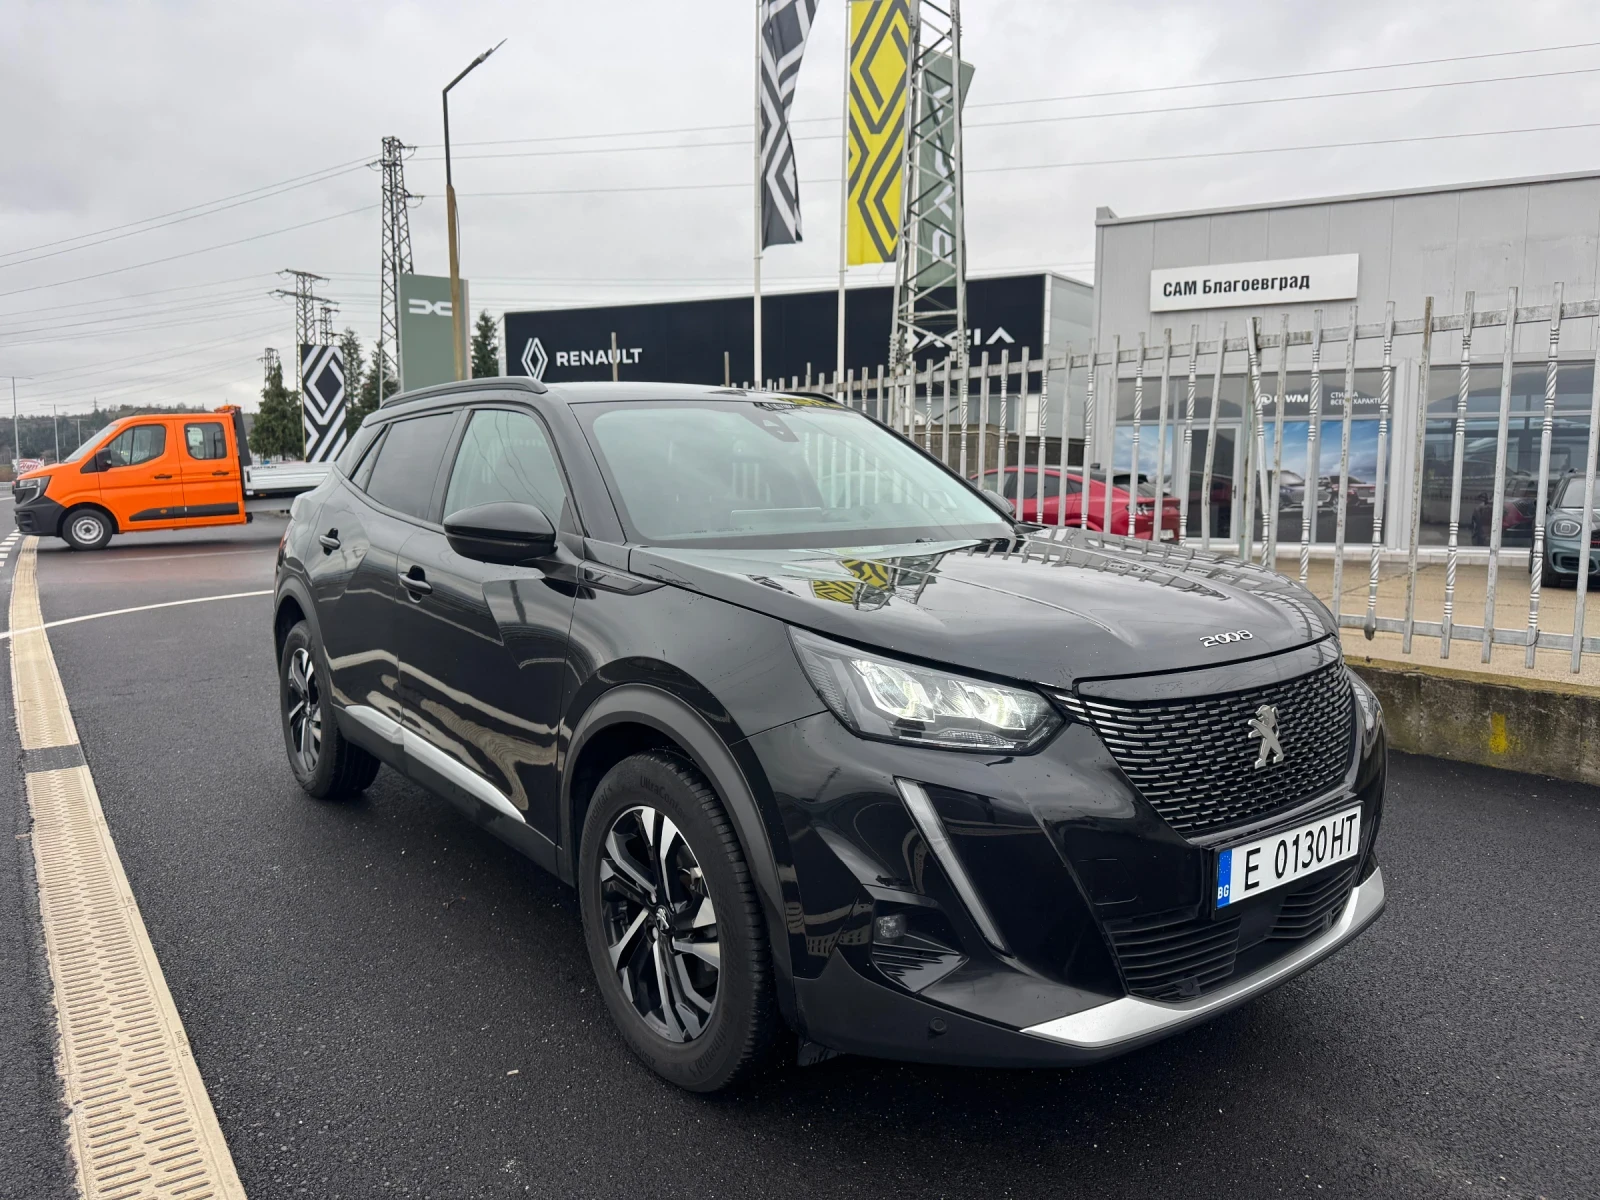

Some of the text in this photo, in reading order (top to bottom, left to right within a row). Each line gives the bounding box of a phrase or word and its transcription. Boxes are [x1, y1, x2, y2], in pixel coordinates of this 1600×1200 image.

[1163, 275, 1310, 297] САМ Благоевград
[556, 348, 643, 367] RENAULT
[1353, 397, 1381, 405] ХАРАКТЕ
[1199, 629, 1253, 648] 2008
[1244, 813, 1357, 891] E 0130HT
[1217, 885, 1229, 899] BG
